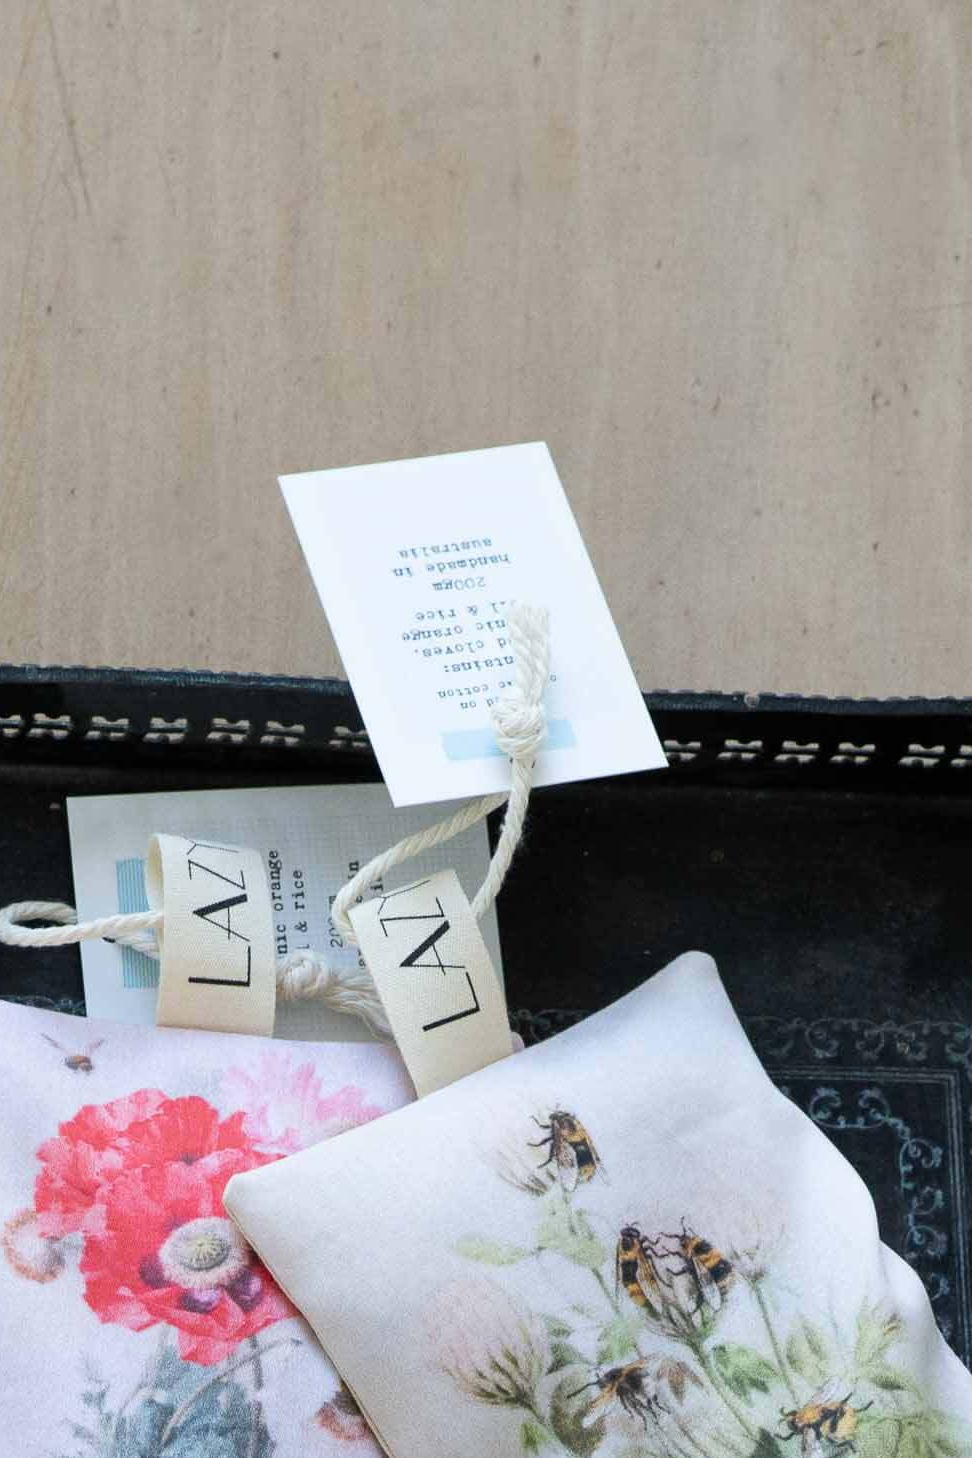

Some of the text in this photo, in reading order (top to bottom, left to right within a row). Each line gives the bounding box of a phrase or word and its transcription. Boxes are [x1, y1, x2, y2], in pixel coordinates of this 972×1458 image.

[399, 537, 493, 559] australia
[392, 553, 512, 577] handmade in
[432, 576, 487, 592] 200gm
[415, 607, 457, 621] rice
[402, 624, 464, 642] orange
[443, 655, 516, 673] ntains:
[437, 683, 489, 699] cotton
[268, 850, 284, 912] orange
[292, 869, 306, 911] rice
[186, 838, 252, 987] LAZY
